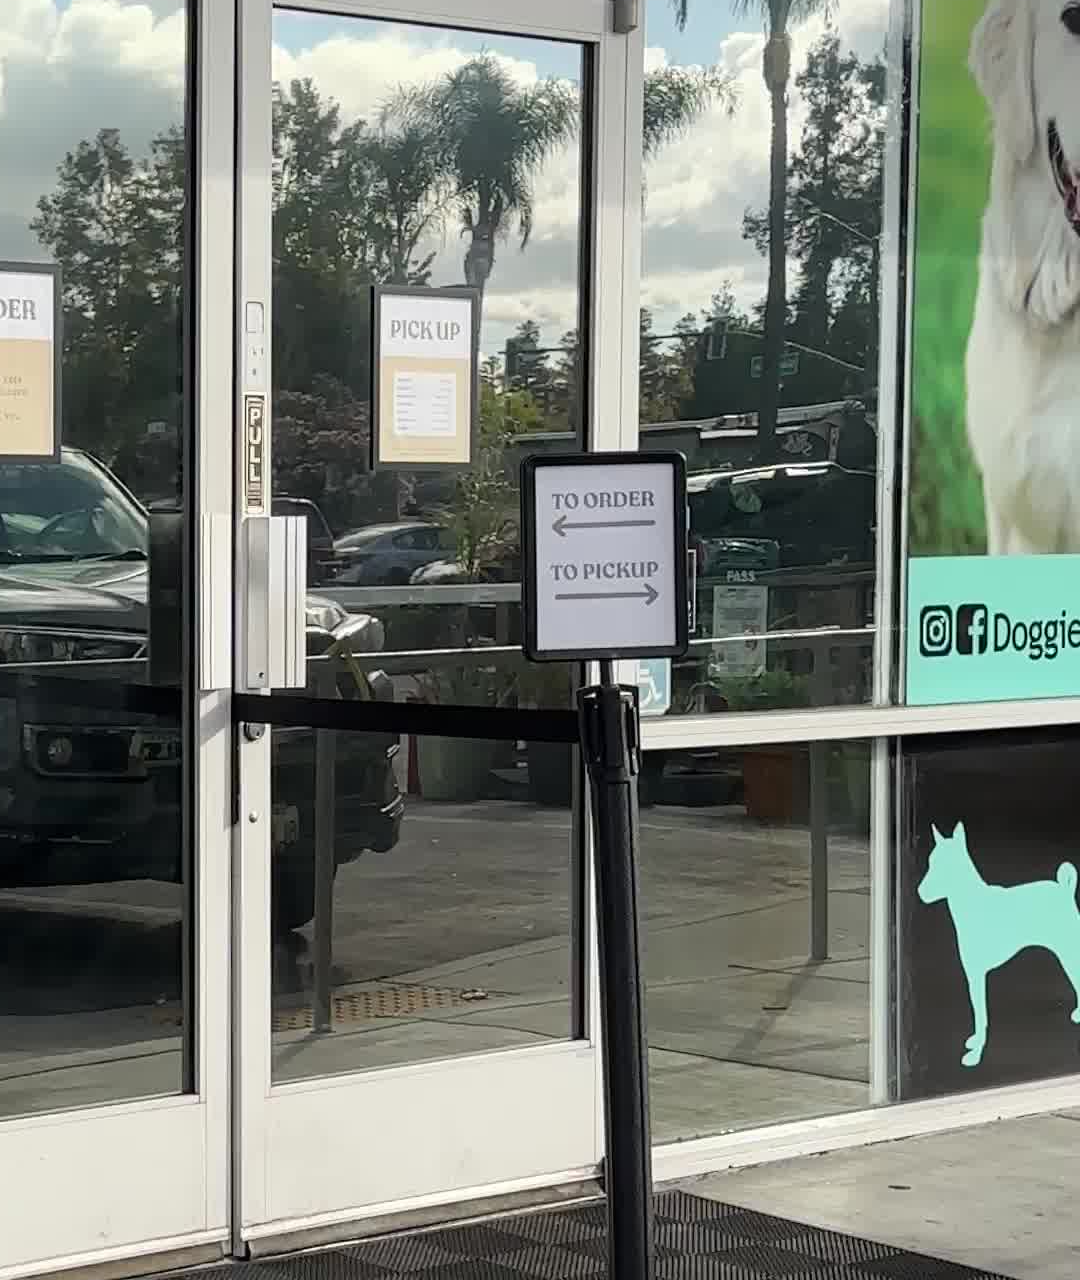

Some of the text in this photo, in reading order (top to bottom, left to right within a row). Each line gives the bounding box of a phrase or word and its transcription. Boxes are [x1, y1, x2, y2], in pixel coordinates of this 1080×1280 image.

[390, 319, 461, 341] PICK UP
[248, 407, 262, 482] PULL
[551, 490, 655, 510] TO ORDER
[550, 561, 659, 581] TO PICKUP
